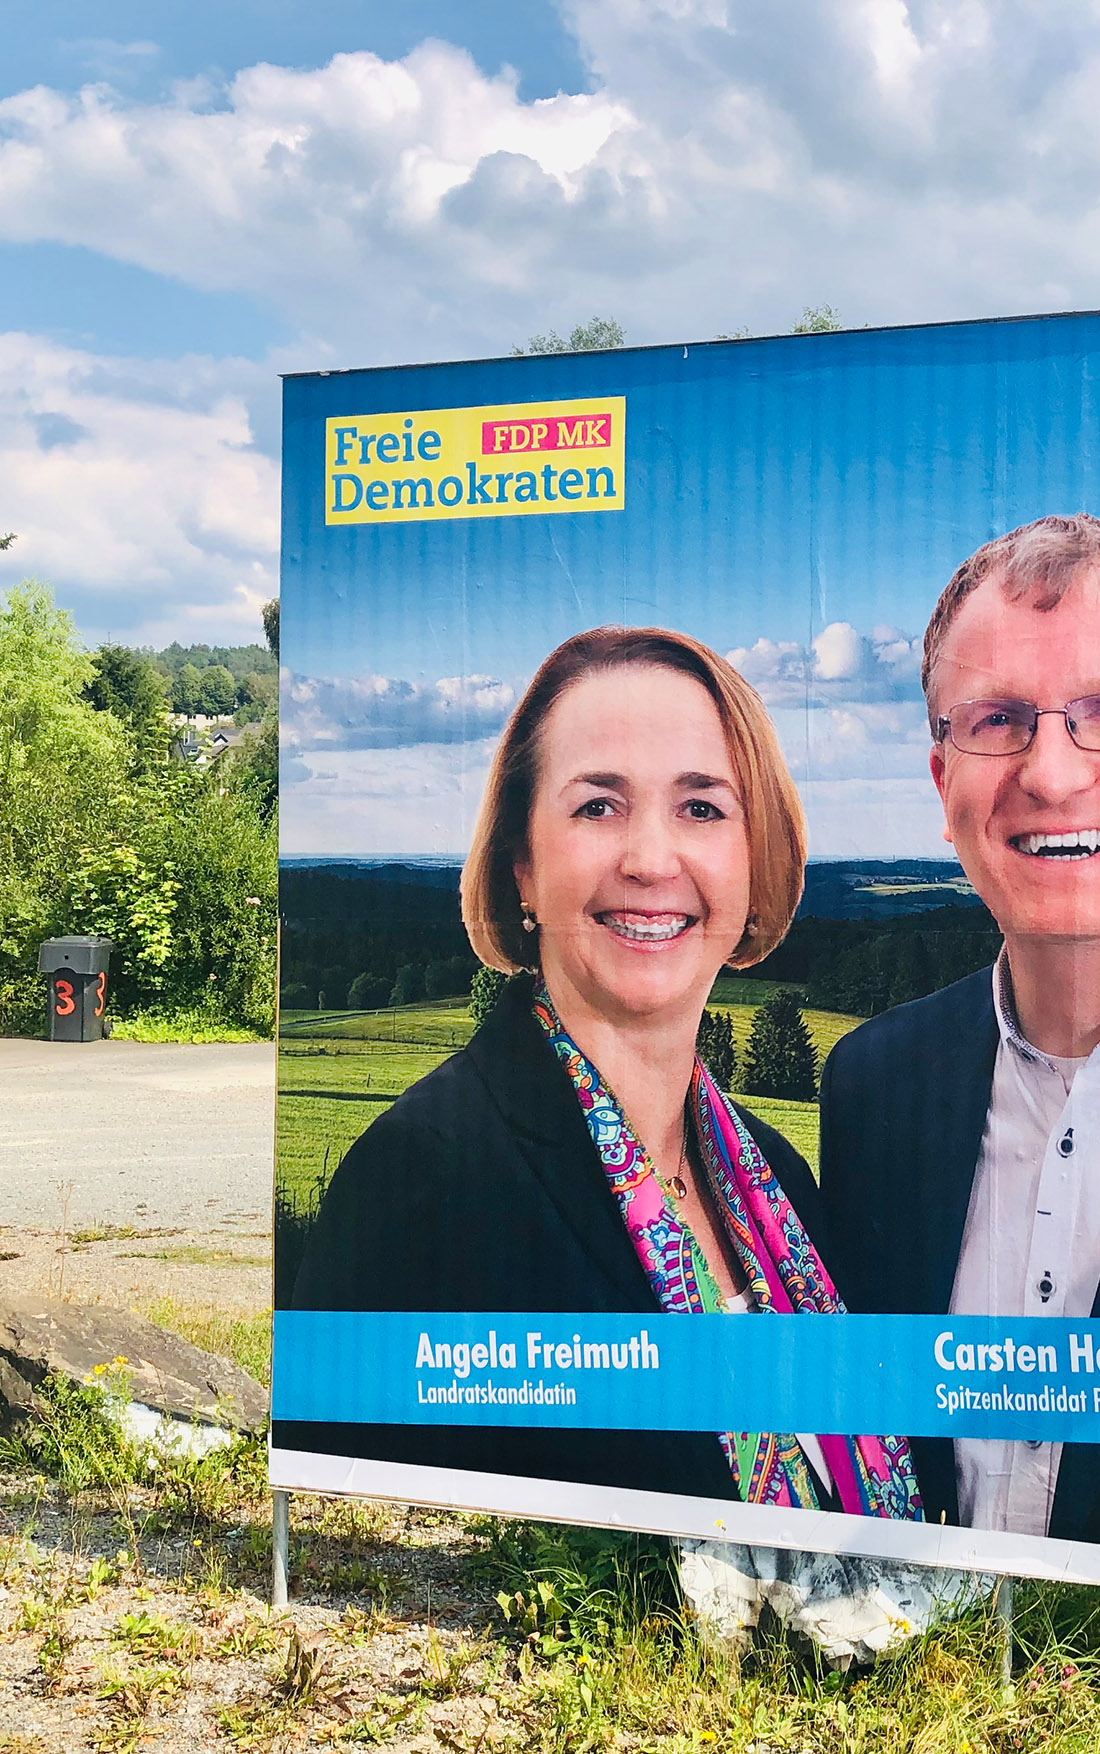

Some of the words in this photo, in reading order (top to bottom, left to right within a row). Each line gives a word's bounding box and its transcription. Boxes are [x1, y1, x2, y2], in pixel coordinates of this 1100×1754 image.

[334, 418, 441, 466] Freie
[493, 423, 548, 451] FDP
[556, 419, 607, 447] MK
[331, 462, 617, 512] Demokraten
[55, 980, 76, 1017] 3
[415, 1330, 517, 1379] Angela
[526, 1330, 659, 1370] Freimuth
[934, 1332, 1058, 1373] Carsten
[417, 1379, 577, 1405] Landratskandidatin
[935, 1383, 1087, 1416] Spitzenkandidat
